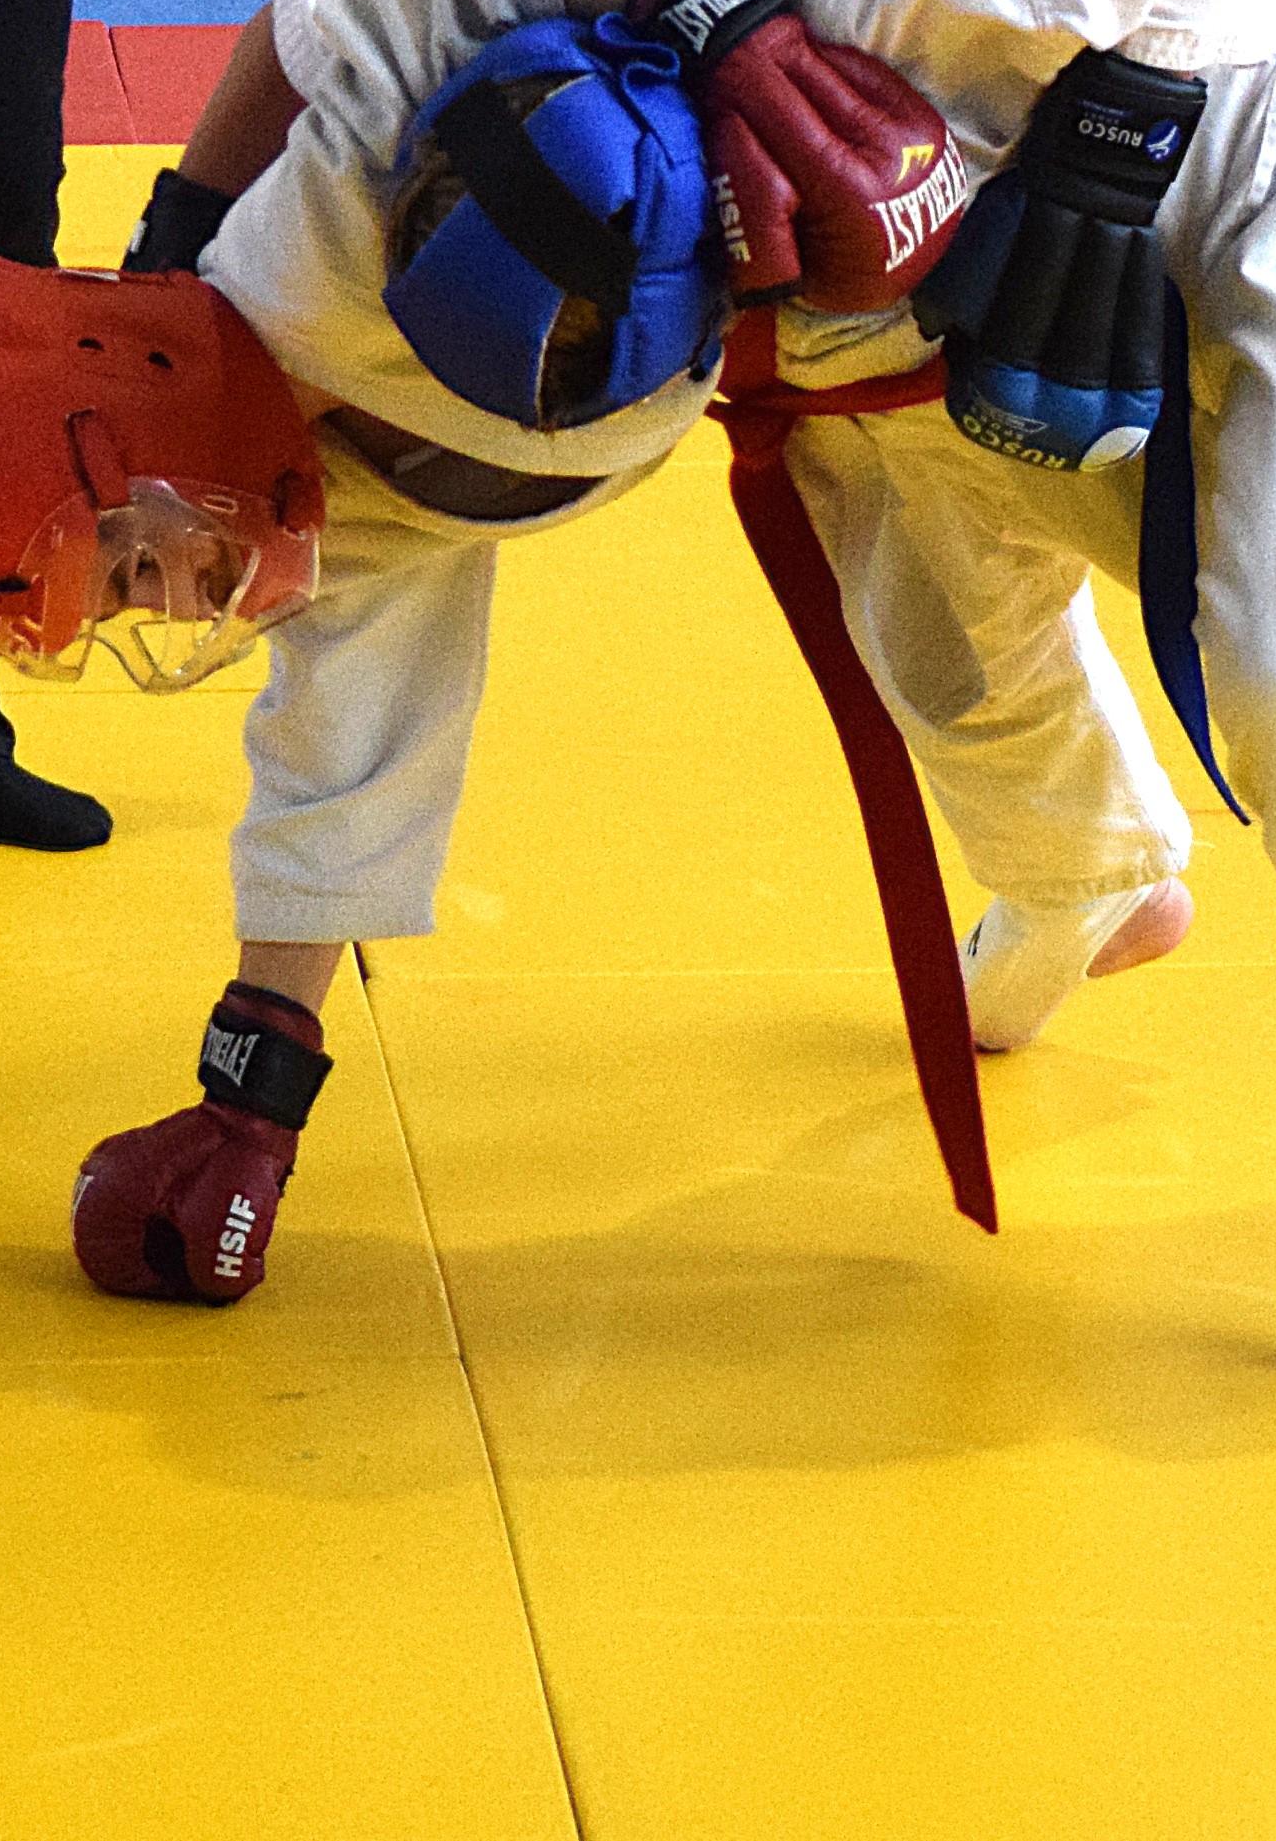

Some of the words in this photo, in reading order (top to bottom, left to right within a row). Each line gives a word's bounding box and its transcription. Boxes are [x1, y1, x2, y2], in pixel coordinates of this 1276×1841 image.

[1078, 119, 1144, 147] RUSCO
[712, 173, 752, 263] HSIF
[874, 128, 968, 273] EVERLAST
[963, 414, 1067, 470] RUSCO
[215, 1194, 258, 1278] HSIF
